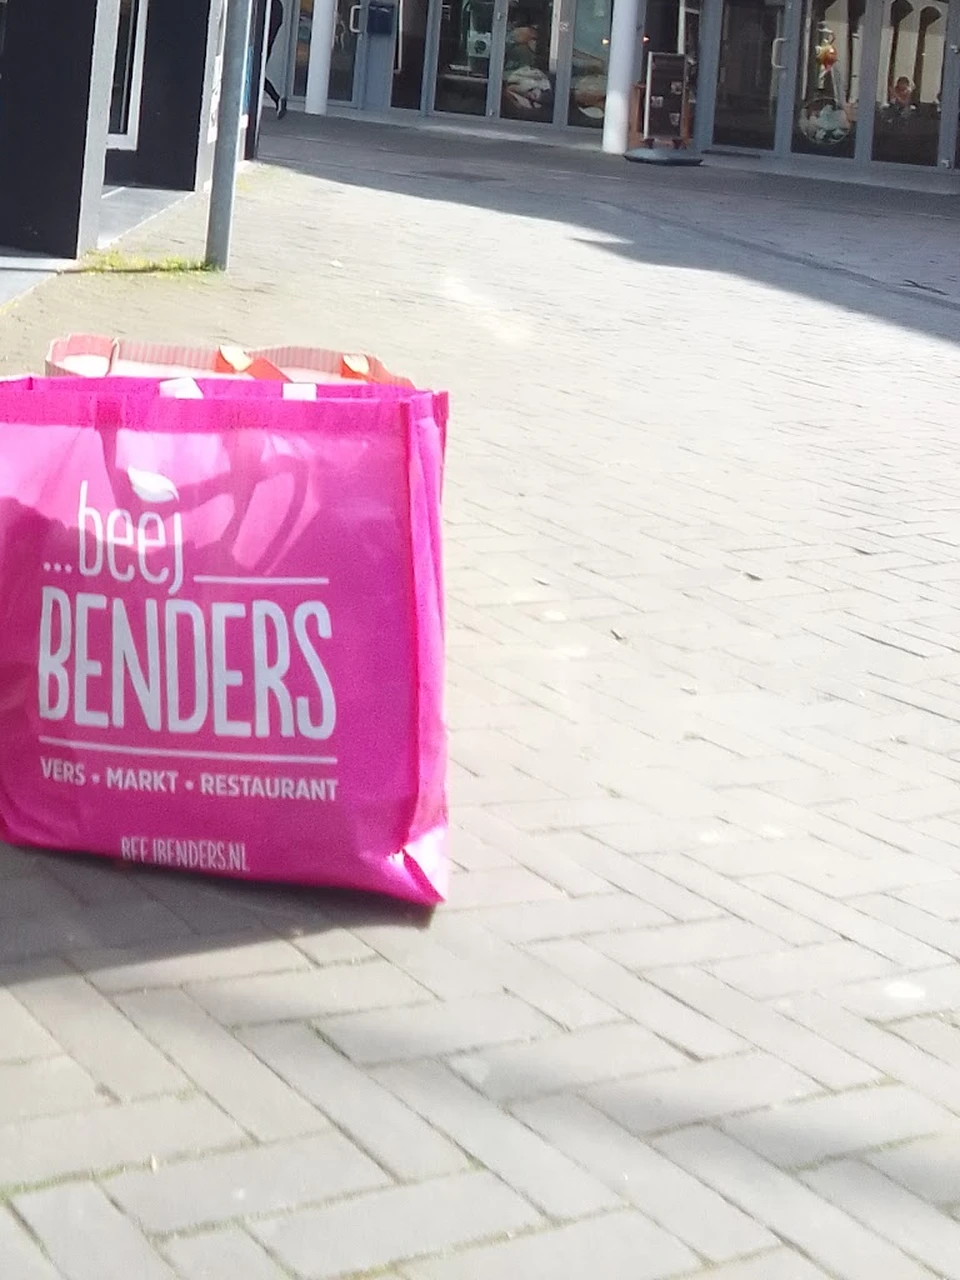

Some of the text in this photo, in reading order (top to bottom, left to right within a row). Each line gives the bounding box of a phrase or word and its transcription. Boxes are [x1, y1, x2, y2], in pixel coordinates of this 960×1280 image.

[38, 585, 337, 740] BENDERS
[40, 756, 338, 801] VERS MARKT RESTAURANT
